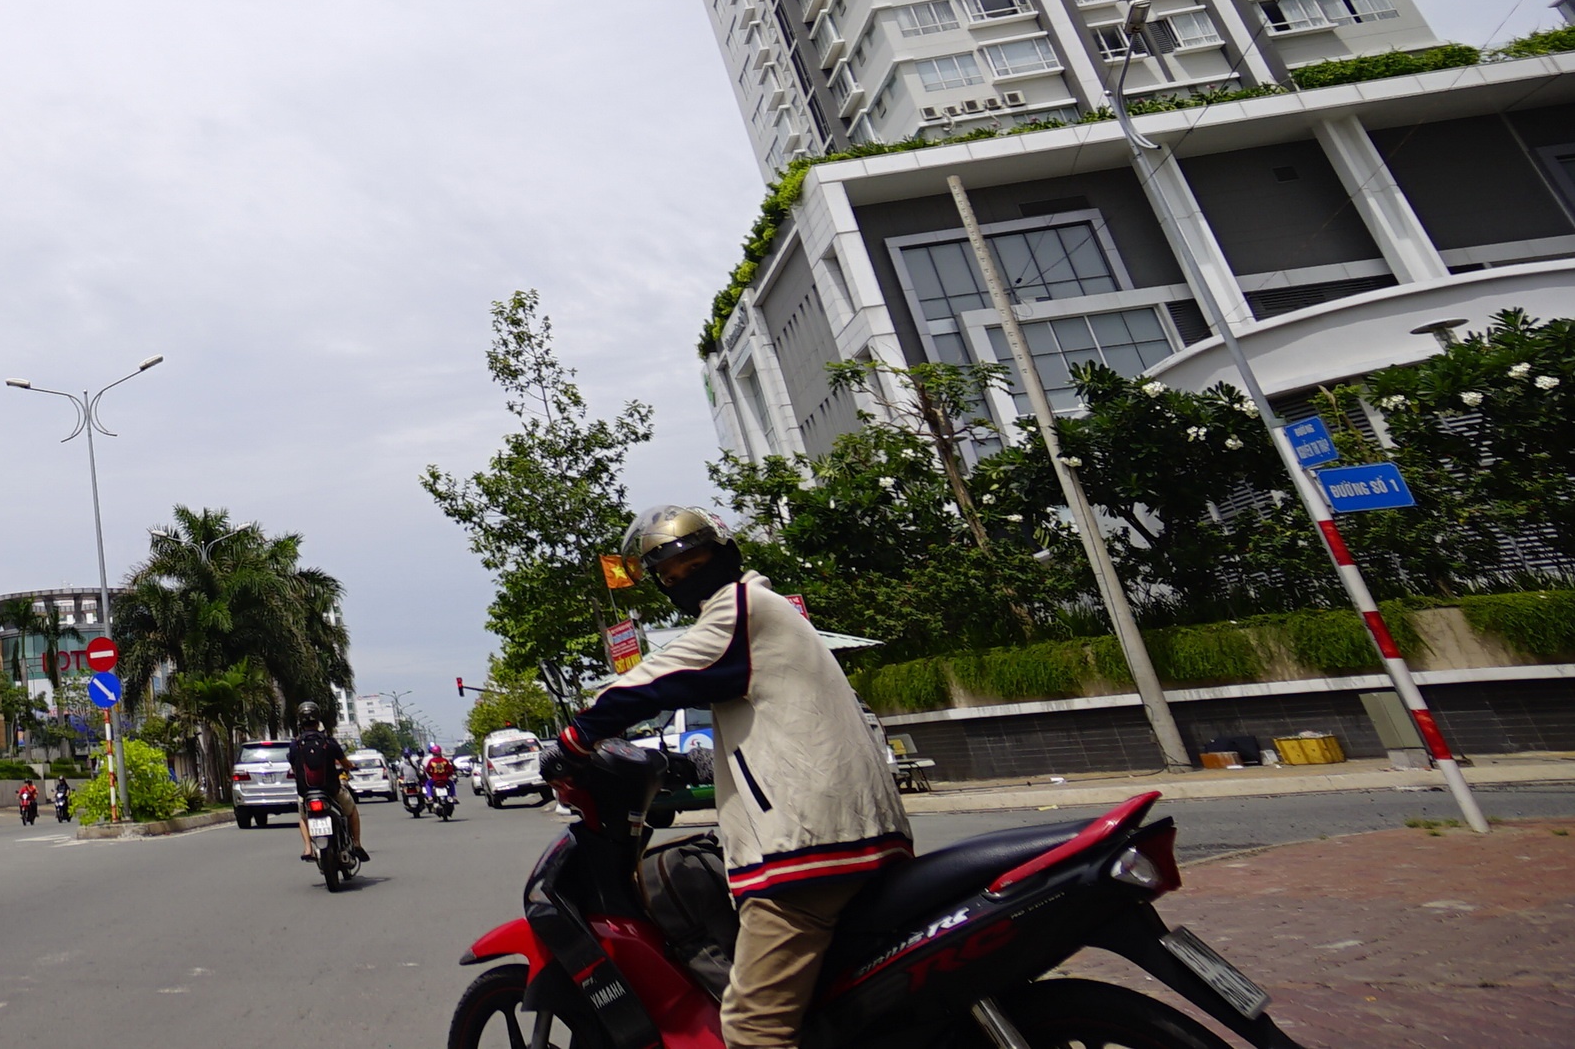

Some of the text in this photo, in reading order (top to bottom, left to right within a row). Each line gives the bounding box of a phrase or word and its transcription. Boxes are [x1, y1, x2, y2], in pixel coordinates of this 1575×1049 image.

[1328, 475, 1400, 499] ĐƯỜNG SỐ 1
[589, 979, 626, 1010] YAMAHA
